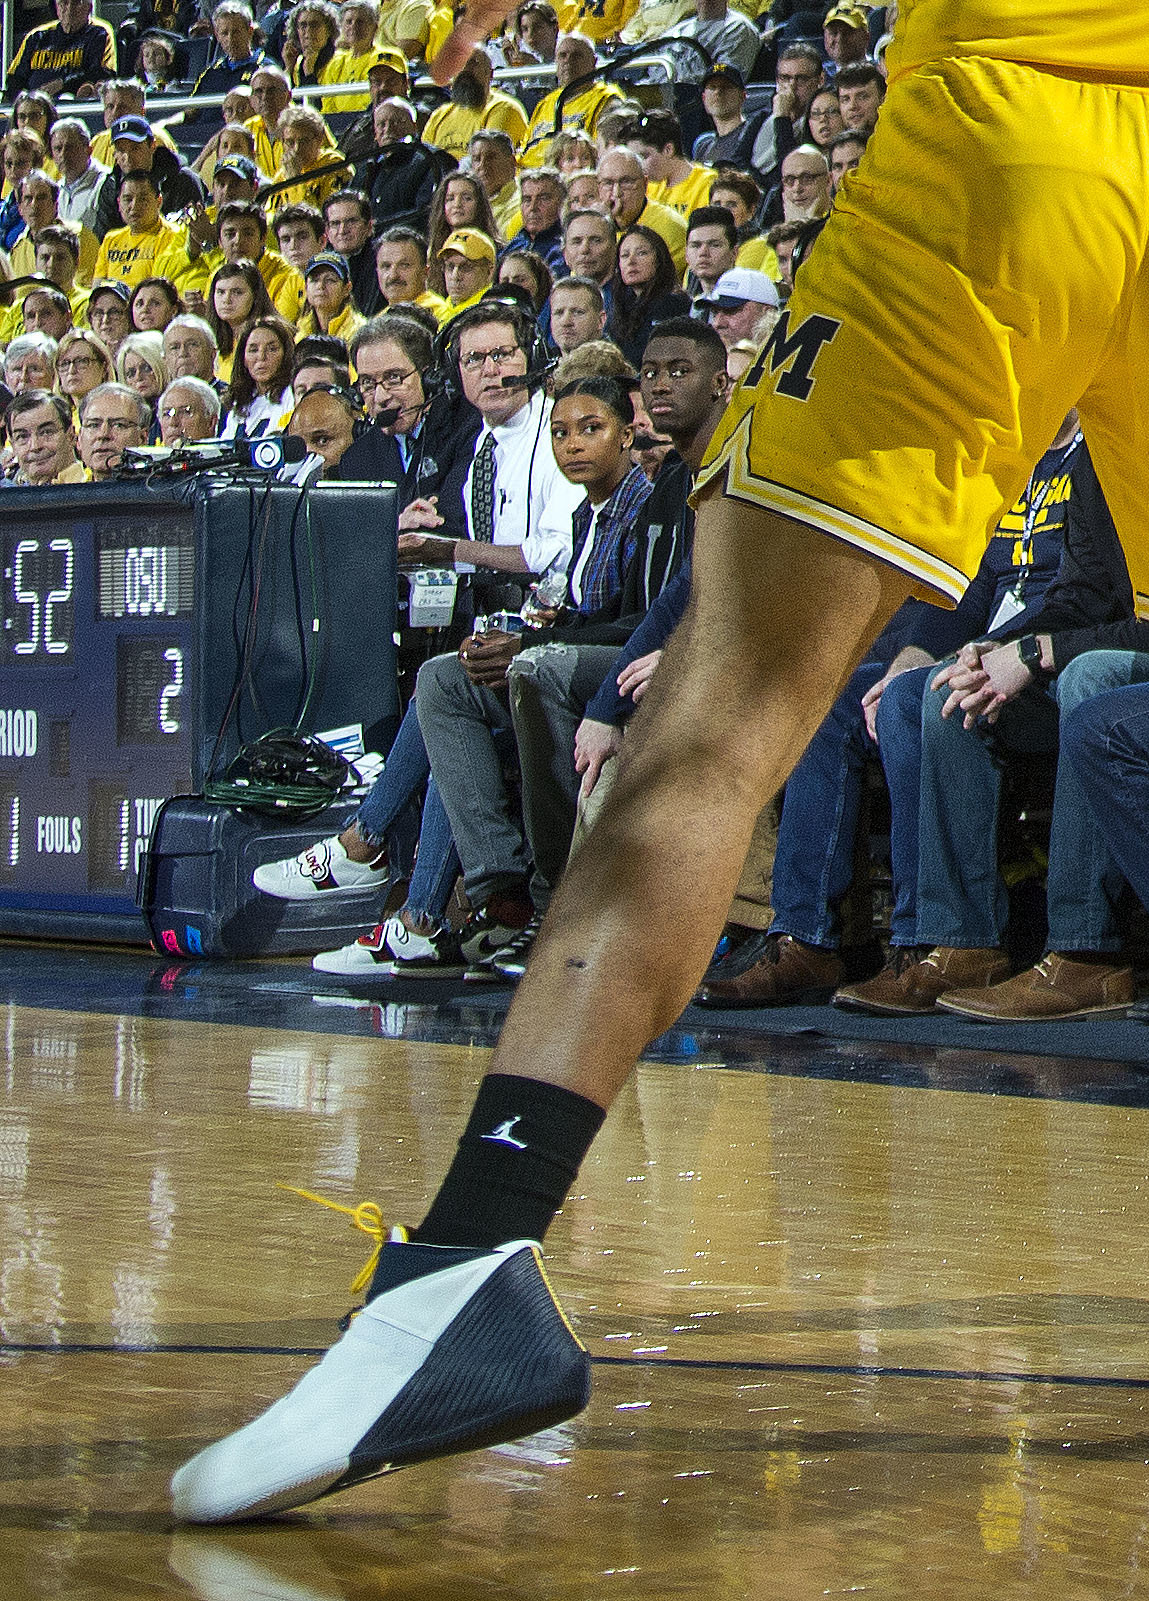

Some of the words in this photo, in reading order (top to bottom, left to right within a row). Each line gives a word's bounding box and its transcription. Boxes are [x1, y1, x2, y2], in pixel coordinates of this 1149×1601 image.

[741, 309, 844, 403] M
[159, 648, 182, 733] 2
[37, 816, 82, 853] FOULS
